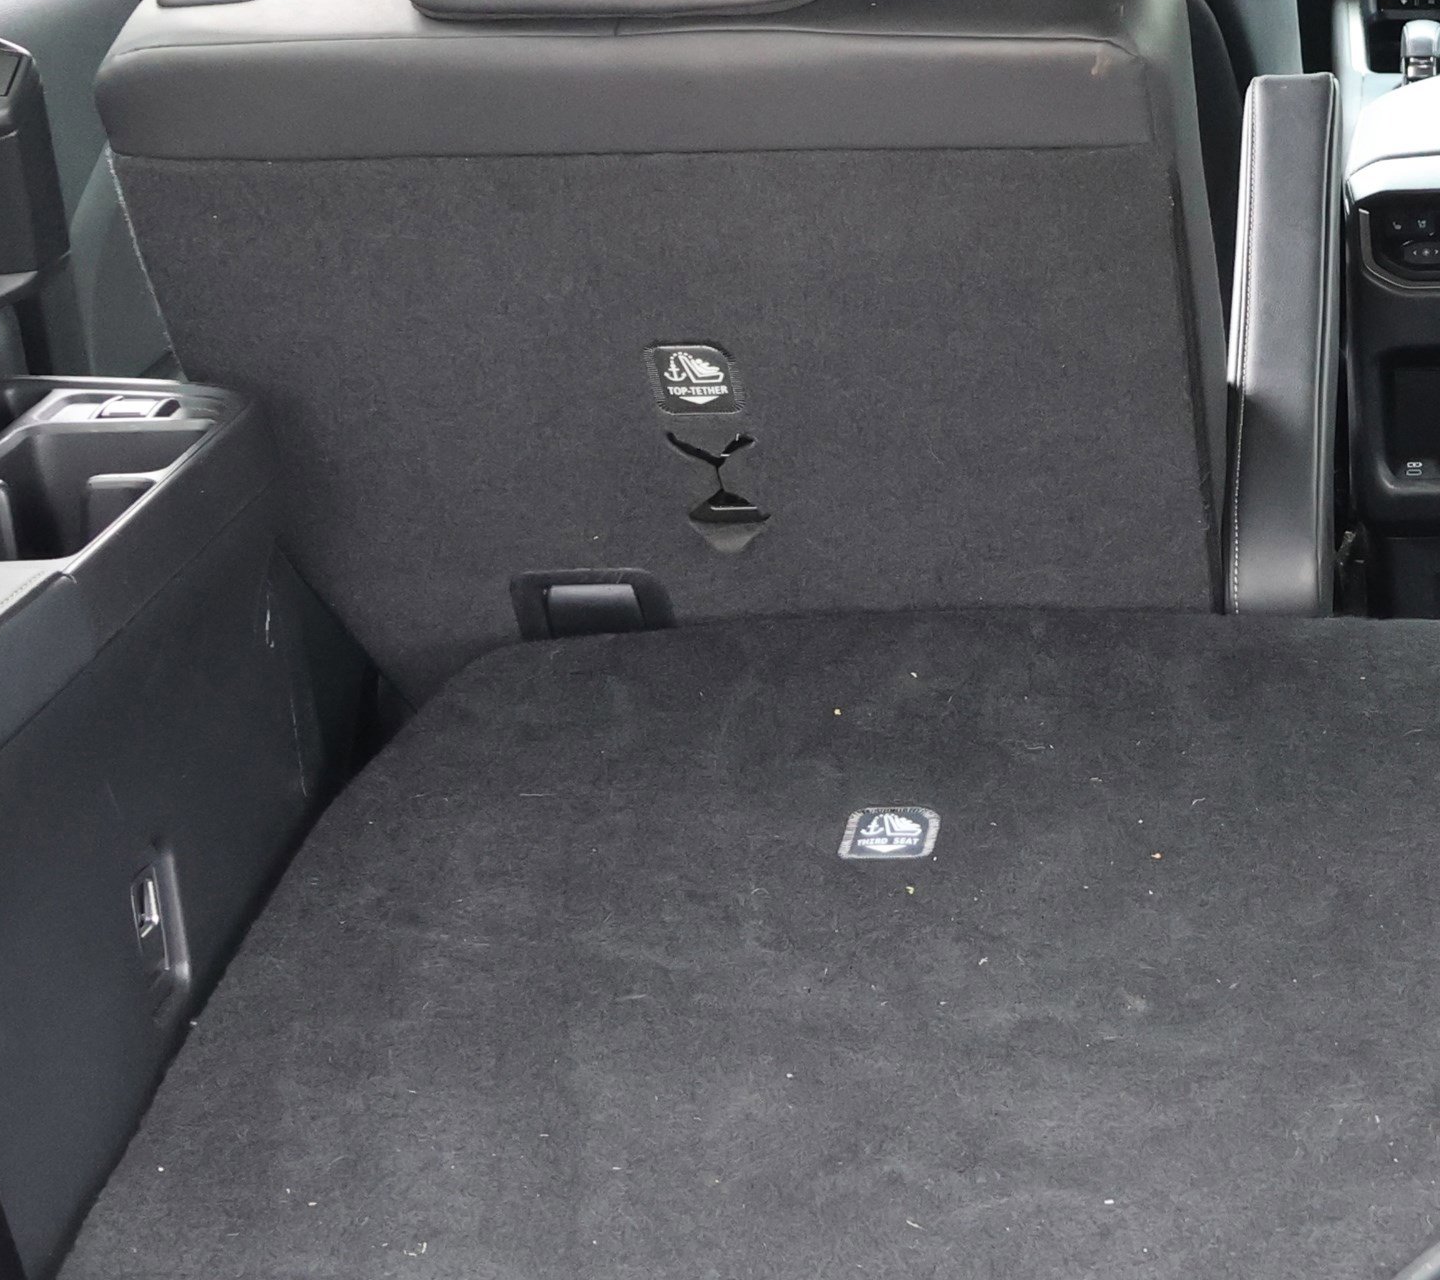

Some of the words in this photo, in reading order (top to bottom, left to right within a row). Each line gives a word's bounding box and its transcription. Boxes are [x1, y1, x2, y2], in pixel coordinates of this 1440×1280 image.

[667, 385, 729, 396] TOP-TETHER
[857, 837, 888, 846] THIRD
[893, 837, 920, 846] SEAT
